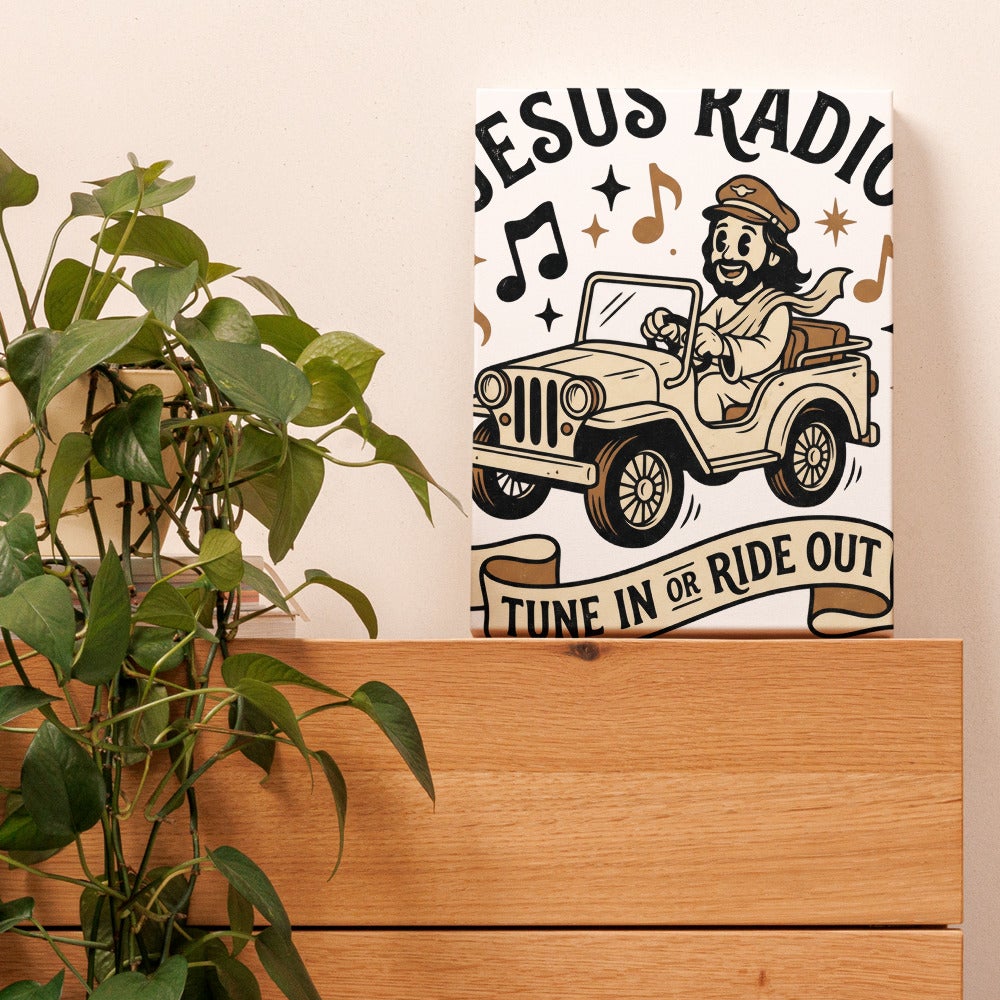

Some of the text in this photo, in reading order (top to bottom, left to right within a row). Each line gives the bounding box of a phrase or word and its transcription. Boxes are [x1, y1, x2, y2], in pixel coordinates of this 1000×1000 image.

[501, 531, 882, 638] TUNE IN OR RIDE OUT
